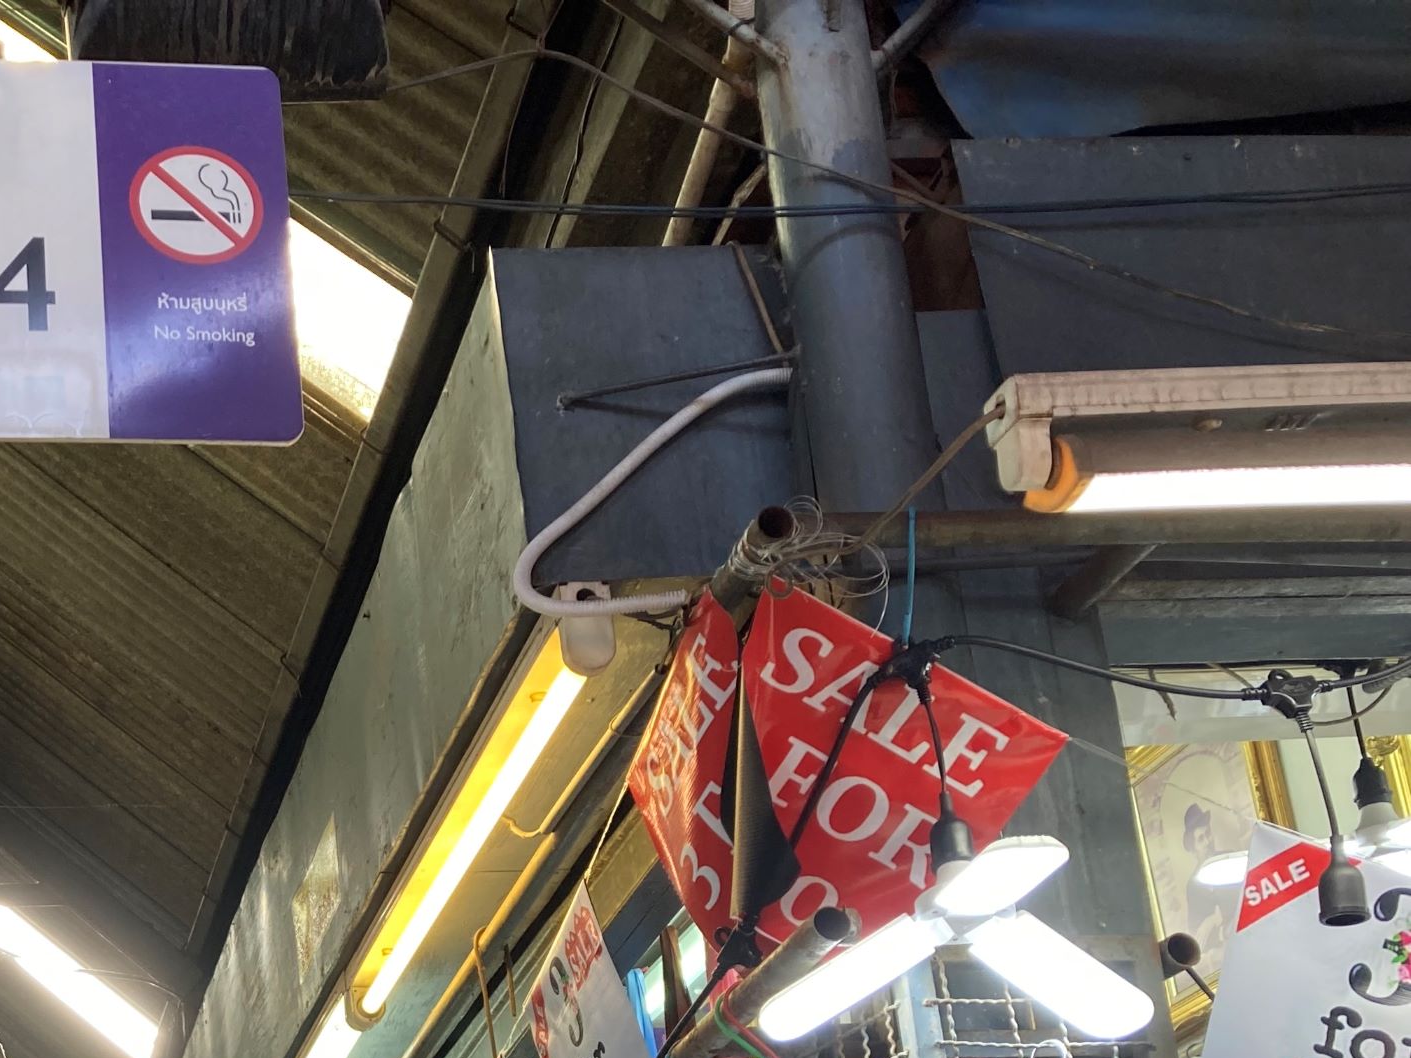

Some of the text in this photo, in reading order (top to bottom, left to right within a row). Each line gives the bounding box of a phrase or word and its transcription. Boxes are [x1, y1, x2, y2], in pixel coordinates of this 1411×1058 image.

[154, 325, 256, 347] No Smoking
[760, 627, 1011, 798] SALE
[769, 735, 941, 890] FOR
[1244, 858, 1311, 908] SALE
